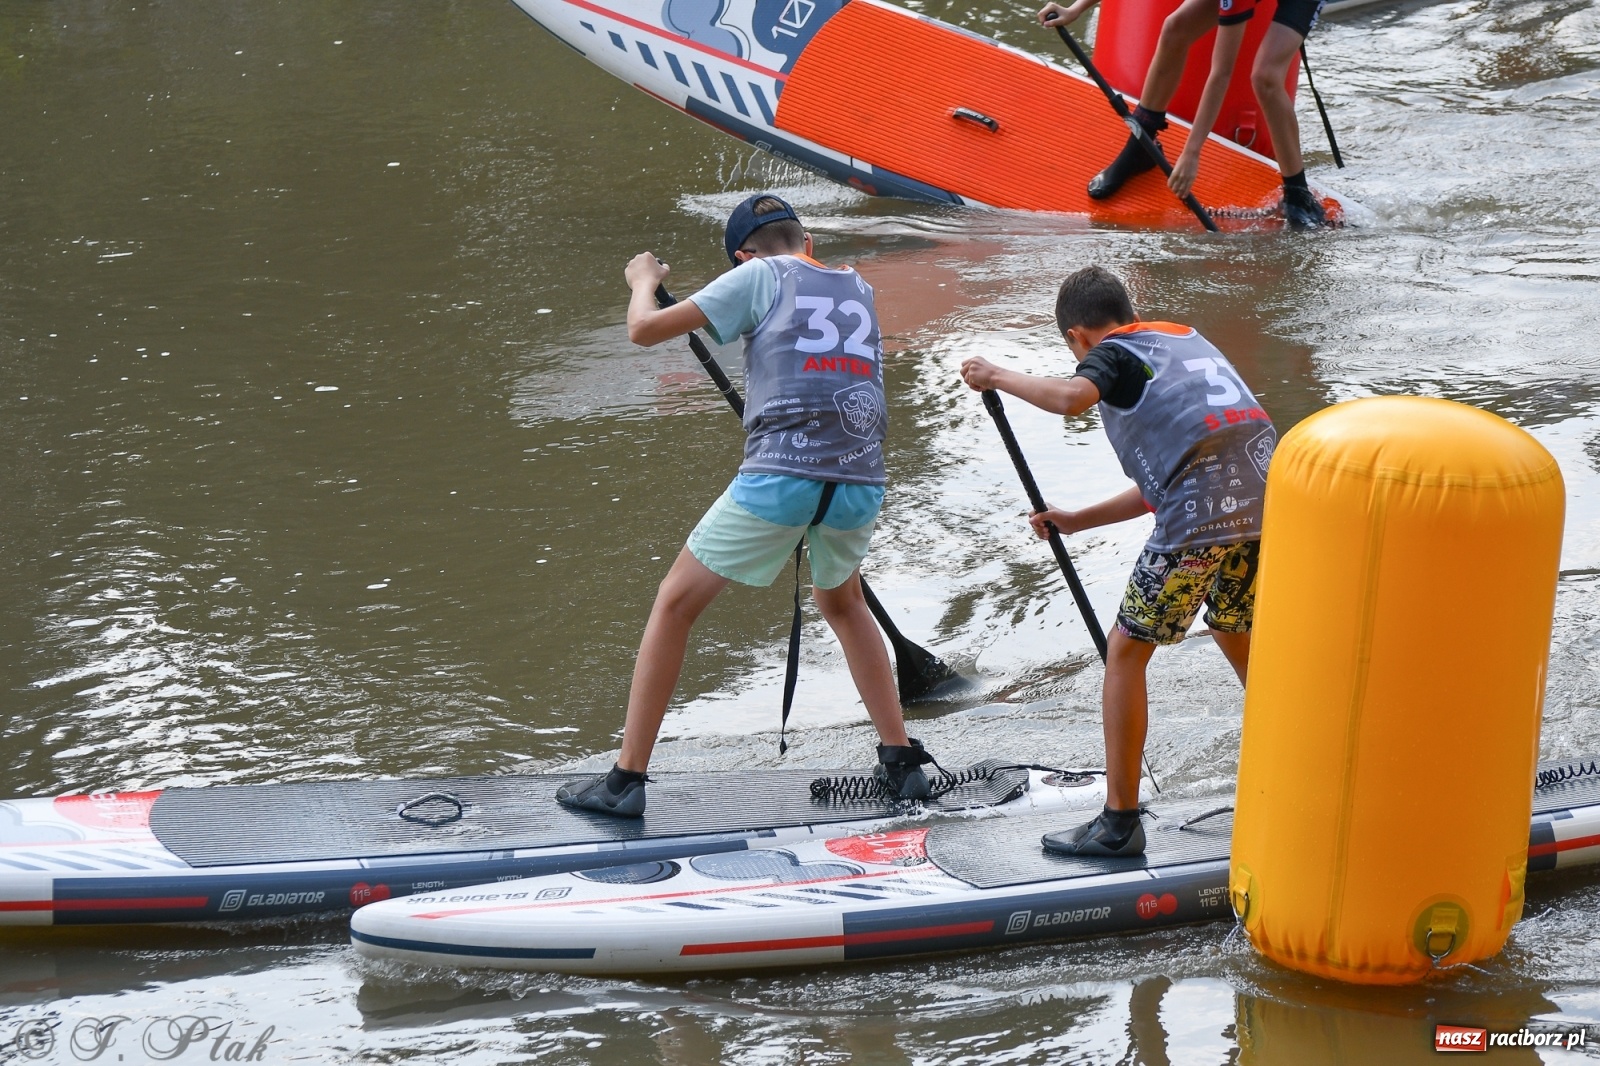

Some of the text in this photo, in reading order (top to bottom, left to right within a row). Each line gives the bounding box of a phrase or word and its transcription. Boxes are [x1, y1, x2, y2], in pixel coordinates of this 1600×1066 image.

[794, 296, 876, 362] 32
[802, 356, 873, 378] ANTEK
[1182, 357, 1258, 407] 3
[1204, 413, 1221, 431] S
[411, 880, 445, 890] LENGTH
[247, 891, 326, 907] GLADIATOR
[406, 892, 529, 905] GLADIATOR
[1033, 906, 1112, 928] GLADIATOR
